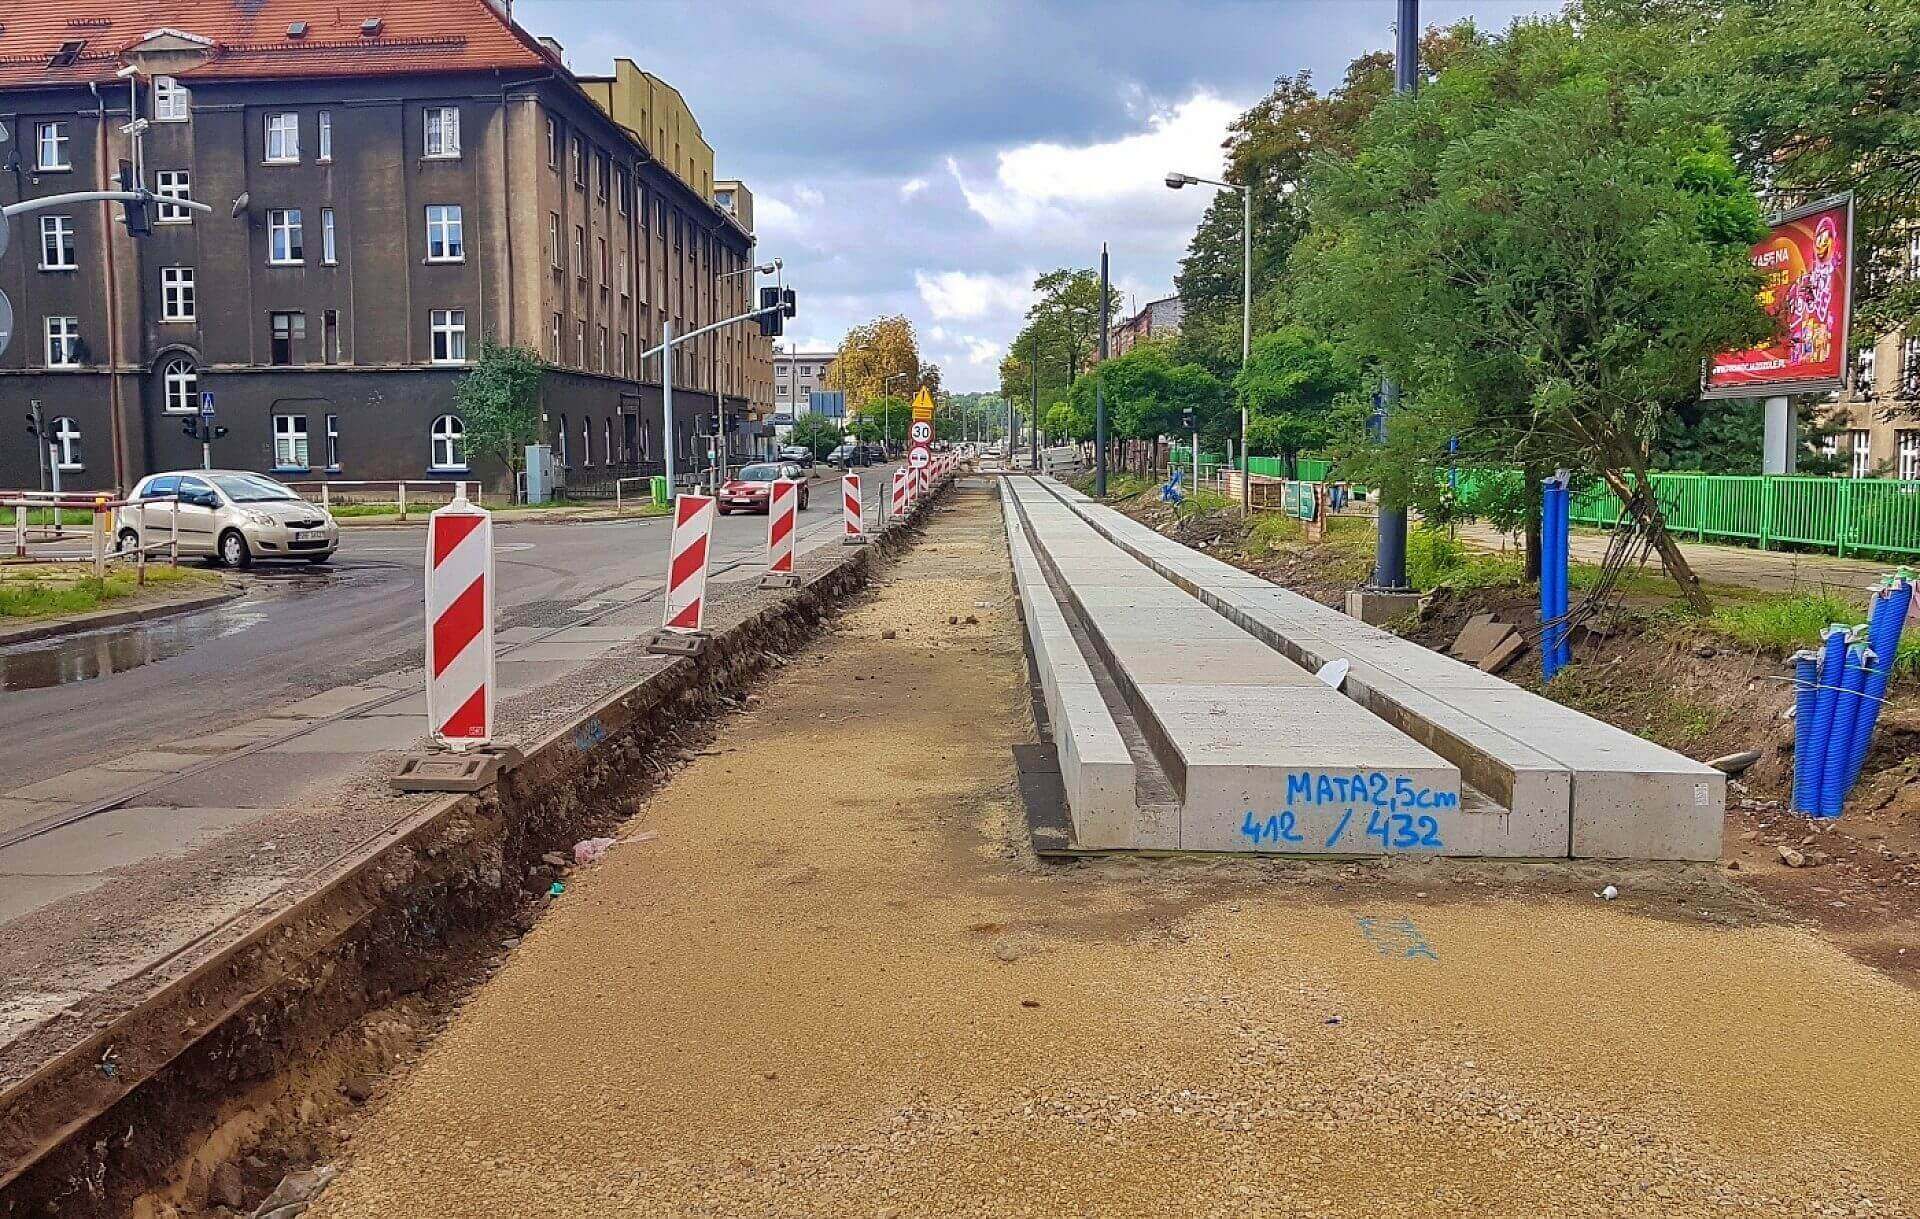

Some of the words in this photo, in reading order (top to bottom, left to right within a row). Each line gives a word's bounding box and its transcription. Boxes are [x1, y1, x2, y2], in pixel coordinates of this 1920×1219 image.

[913, 426, 929, 438] 30
[1241, 810, 1304, 843] 412
[1325, 808, 1353, 847] /
[1366, 810, 1443, 847] 432
